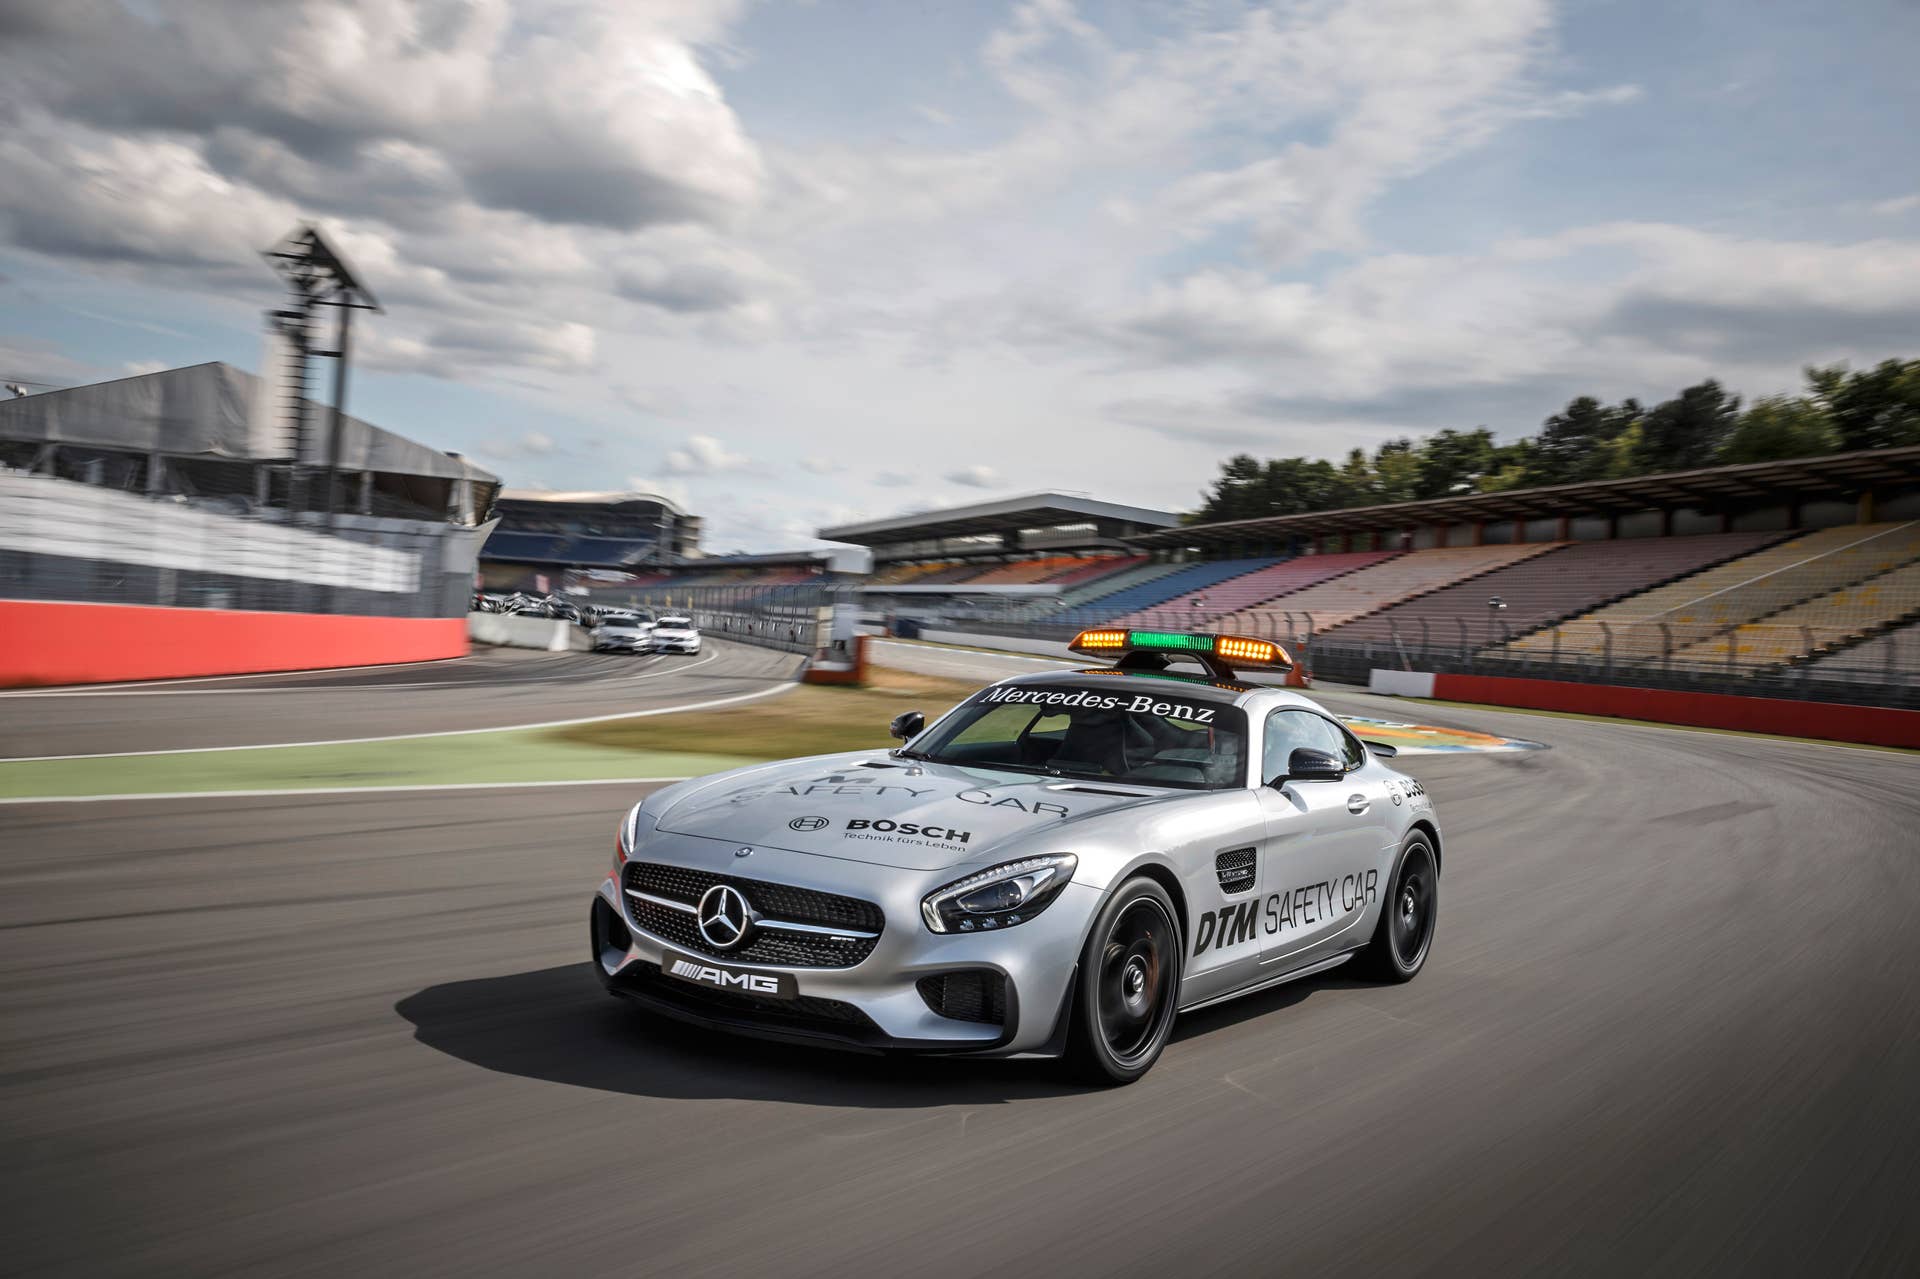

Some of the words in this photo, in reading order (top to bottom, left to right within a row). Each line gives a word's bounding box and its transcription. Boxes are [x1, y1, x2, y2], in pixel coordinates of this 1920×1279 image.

[979, 687, 1216, 723] Mercedes-Benz
[730, 784, 936, 803] SAFETY
[954, 789, 1069, 818] CAR
[843, 832, 895, 843] Technik
[925, 840, 967, 853] Leben
[846, 819, 971, 844] BOSCH
[1193, 899, 1260, 957] DTM
[1264, 878, 1338, 935] SAFETY
[1341, 869, 1378, 912] CAR
[699, 966, 778, 993] AMG
